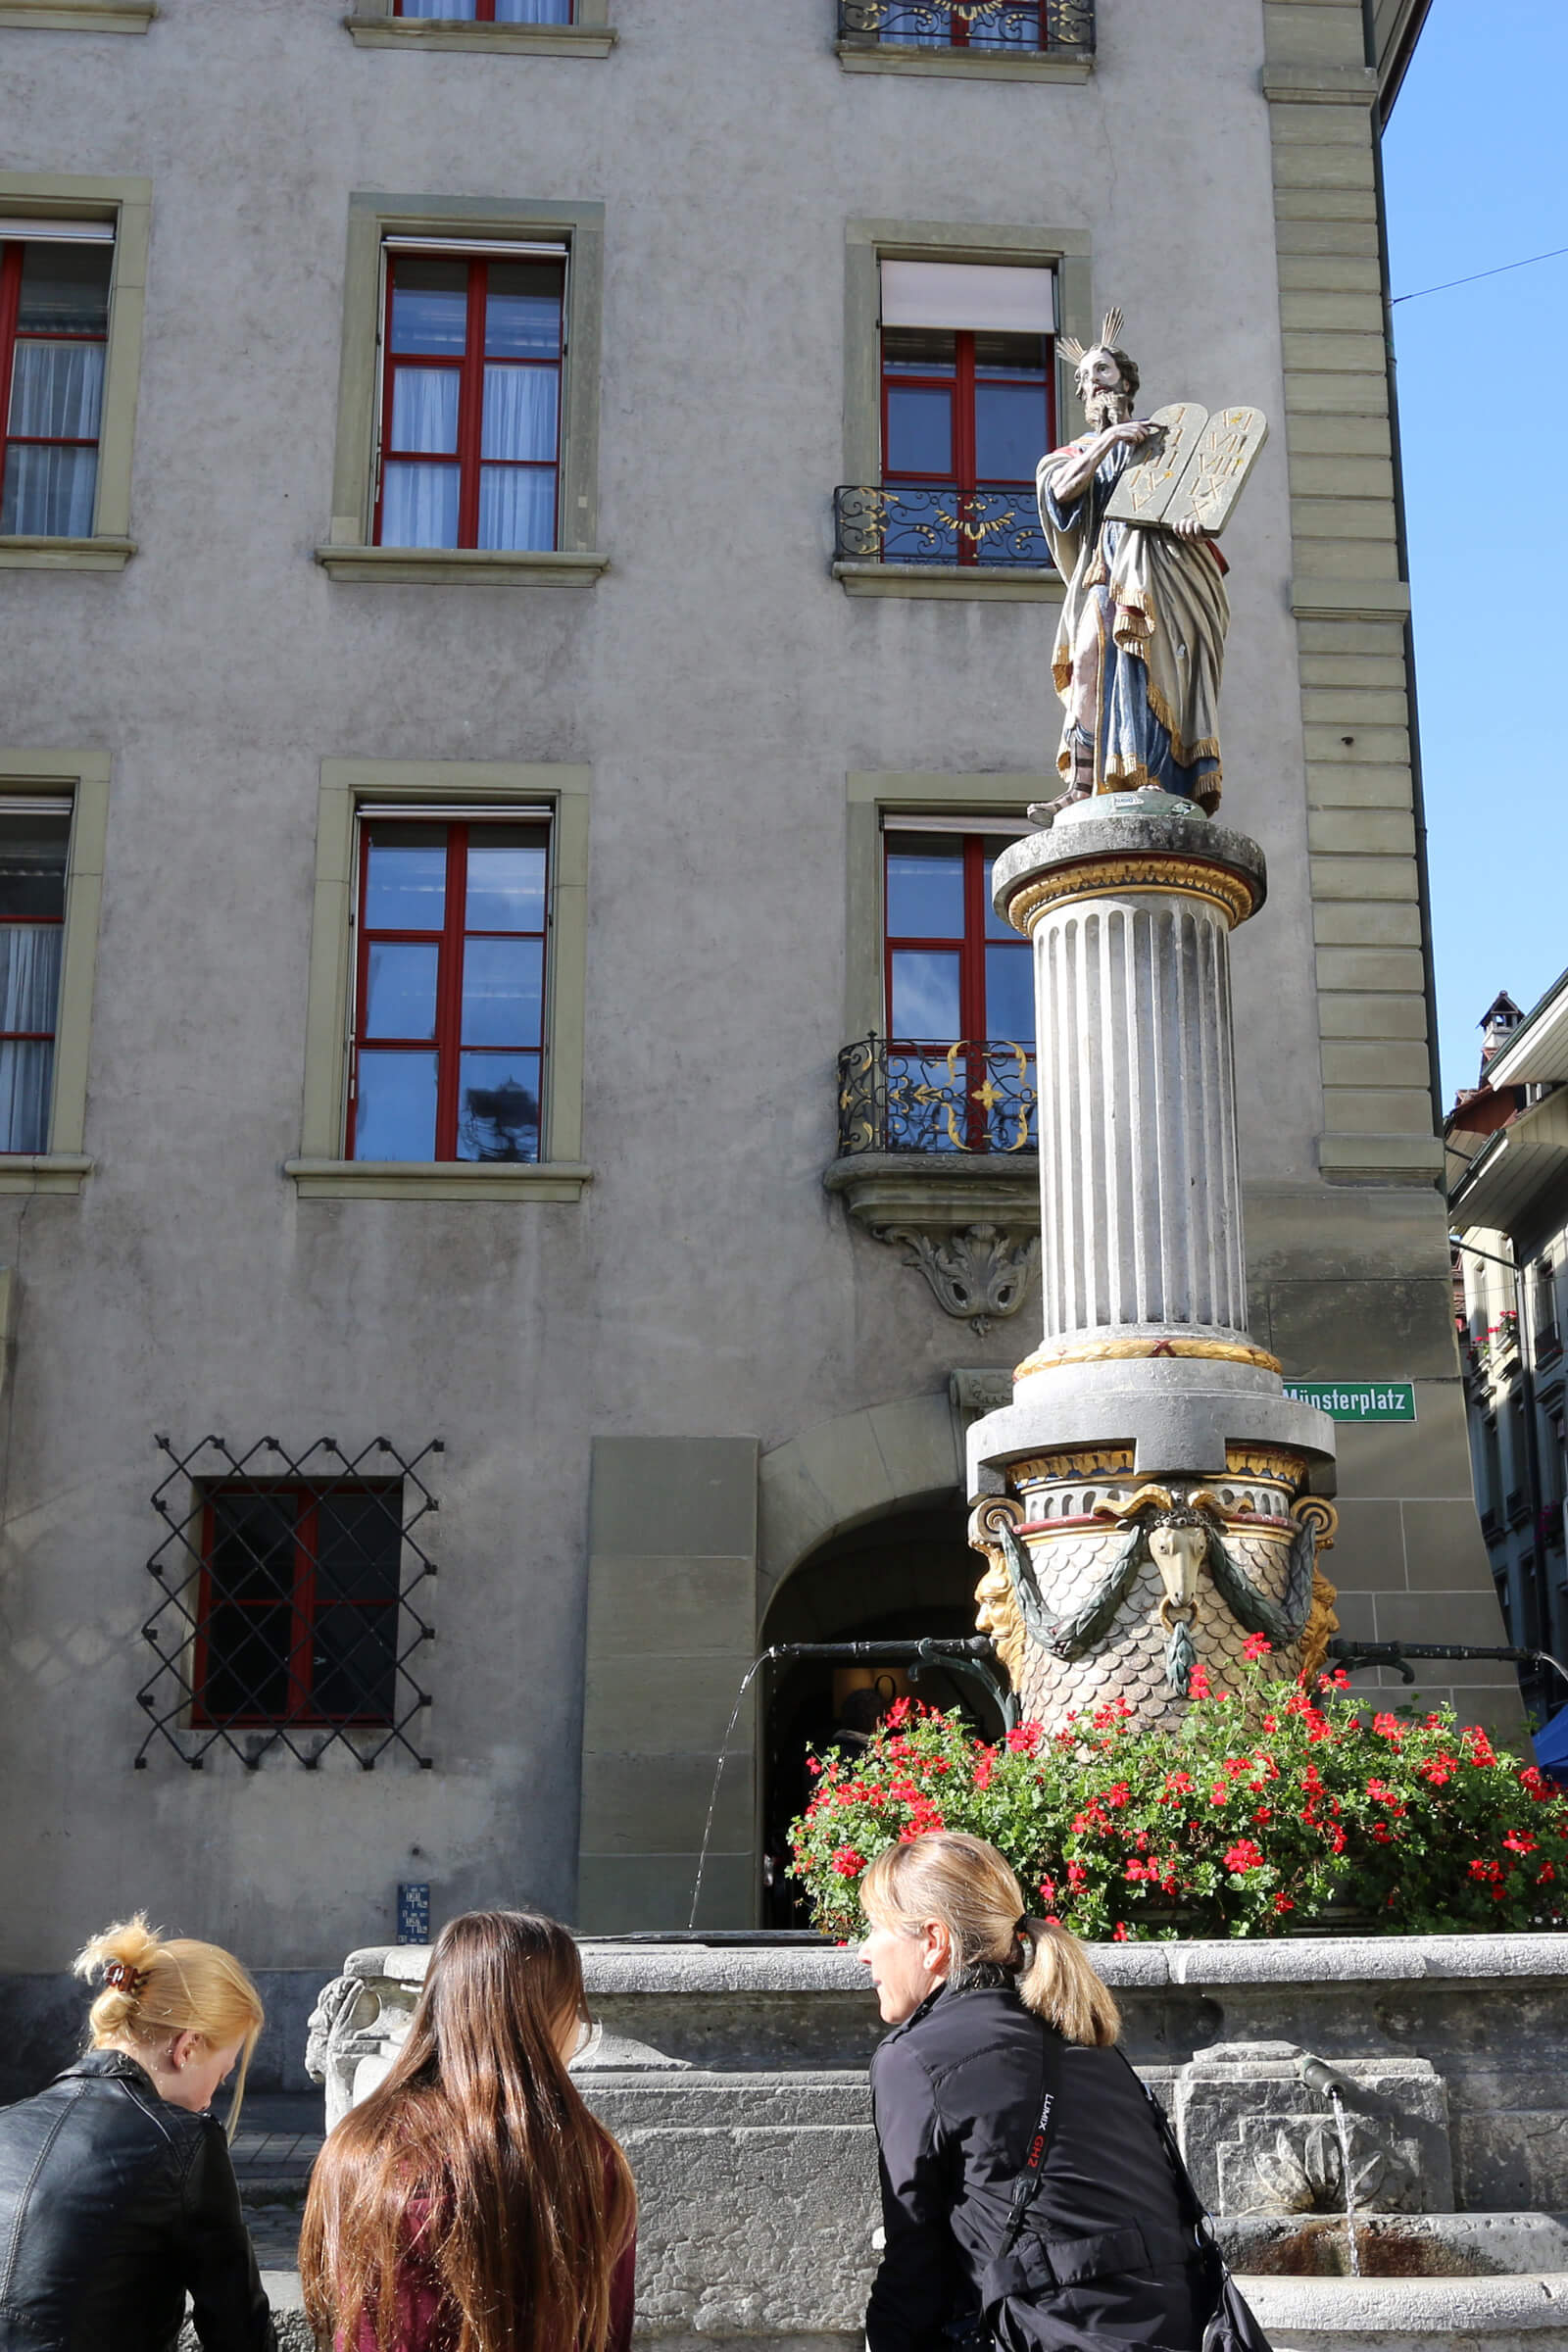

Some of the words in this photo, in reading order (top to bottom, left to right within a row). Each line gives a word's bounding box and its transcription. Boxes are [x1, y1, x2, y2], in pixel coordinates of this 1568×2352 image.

[1222, 410, 1254, 431] VI
[1210, 431, 1248, 454] VII
[1199, 454, 1242, 476] VIII
[1129, 469, 1171, 491] IV
[1188, 476, 1229, 500] IX
[1131, 492, 1156, 512] V
[1183, 500, 1210, 521] X
[1038, 2092, 1055, 2132] LUMIX
[1027, 2134, 1045, 2168] GH2
